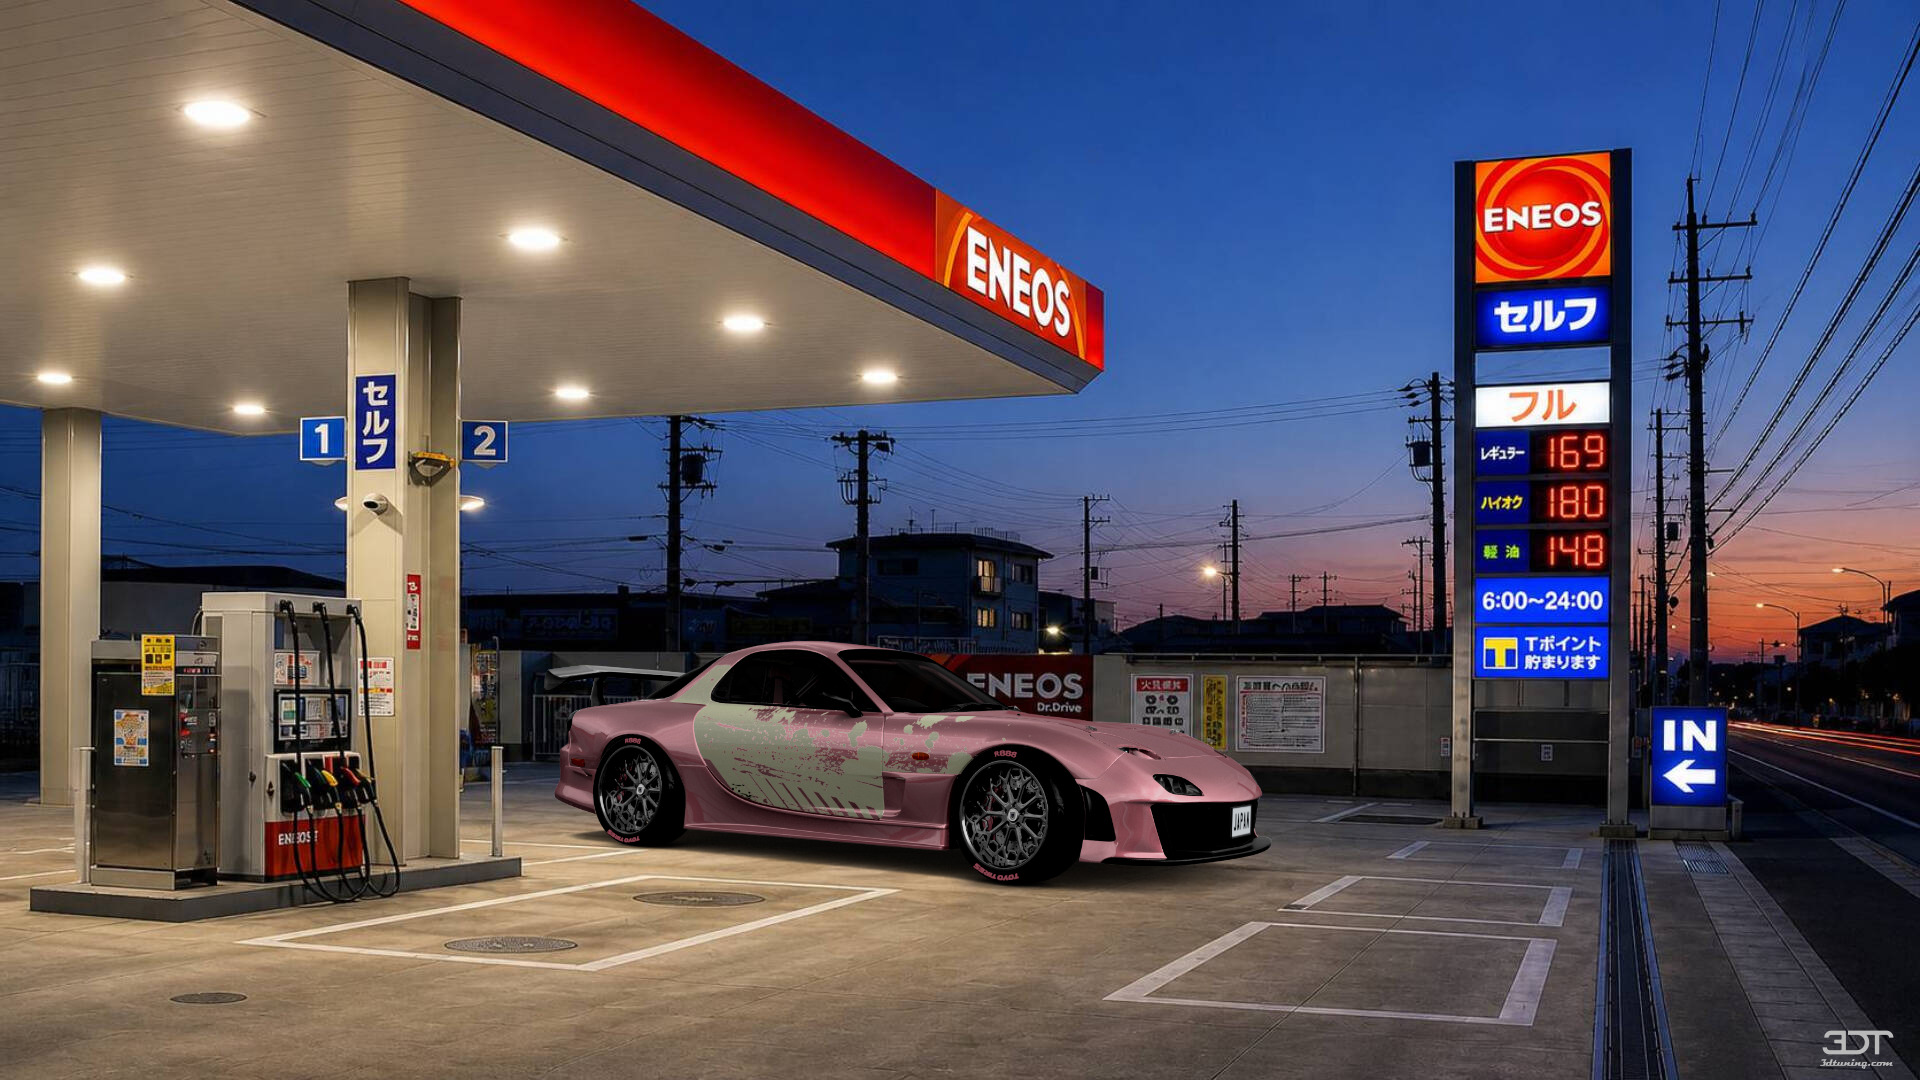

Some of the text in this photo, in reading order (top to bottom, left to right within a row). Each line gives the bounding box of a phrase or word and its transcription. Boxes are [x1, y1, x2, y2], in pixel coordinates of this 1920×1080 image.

[1484, 201, 1602, 232] ENEOS
[967, 226, 1071, 337] ENEOS
[1494, 298, 1597, 332] セルフ
[1509, 389, 1577, 422] フル
[362, 381, 389, 464] セルフ
[314, 423, 329, 454] 1
[474, 425, 496, 456] 2
[1480, 435, 1604, 468] レギュラー 169
[1480, 485, 1604, 518] ハイオク 180
[1550, 534, 1604, 566] 148
[1524, 635, 1601, 652] Tポイント
[1524, 655, 1601, 670] 貯まります
[1037, 702, 1082, 713] Dr.Drive
[1663, 720, 1717, 751] IN
[1234, 811, 1250, 831] JAPAN
